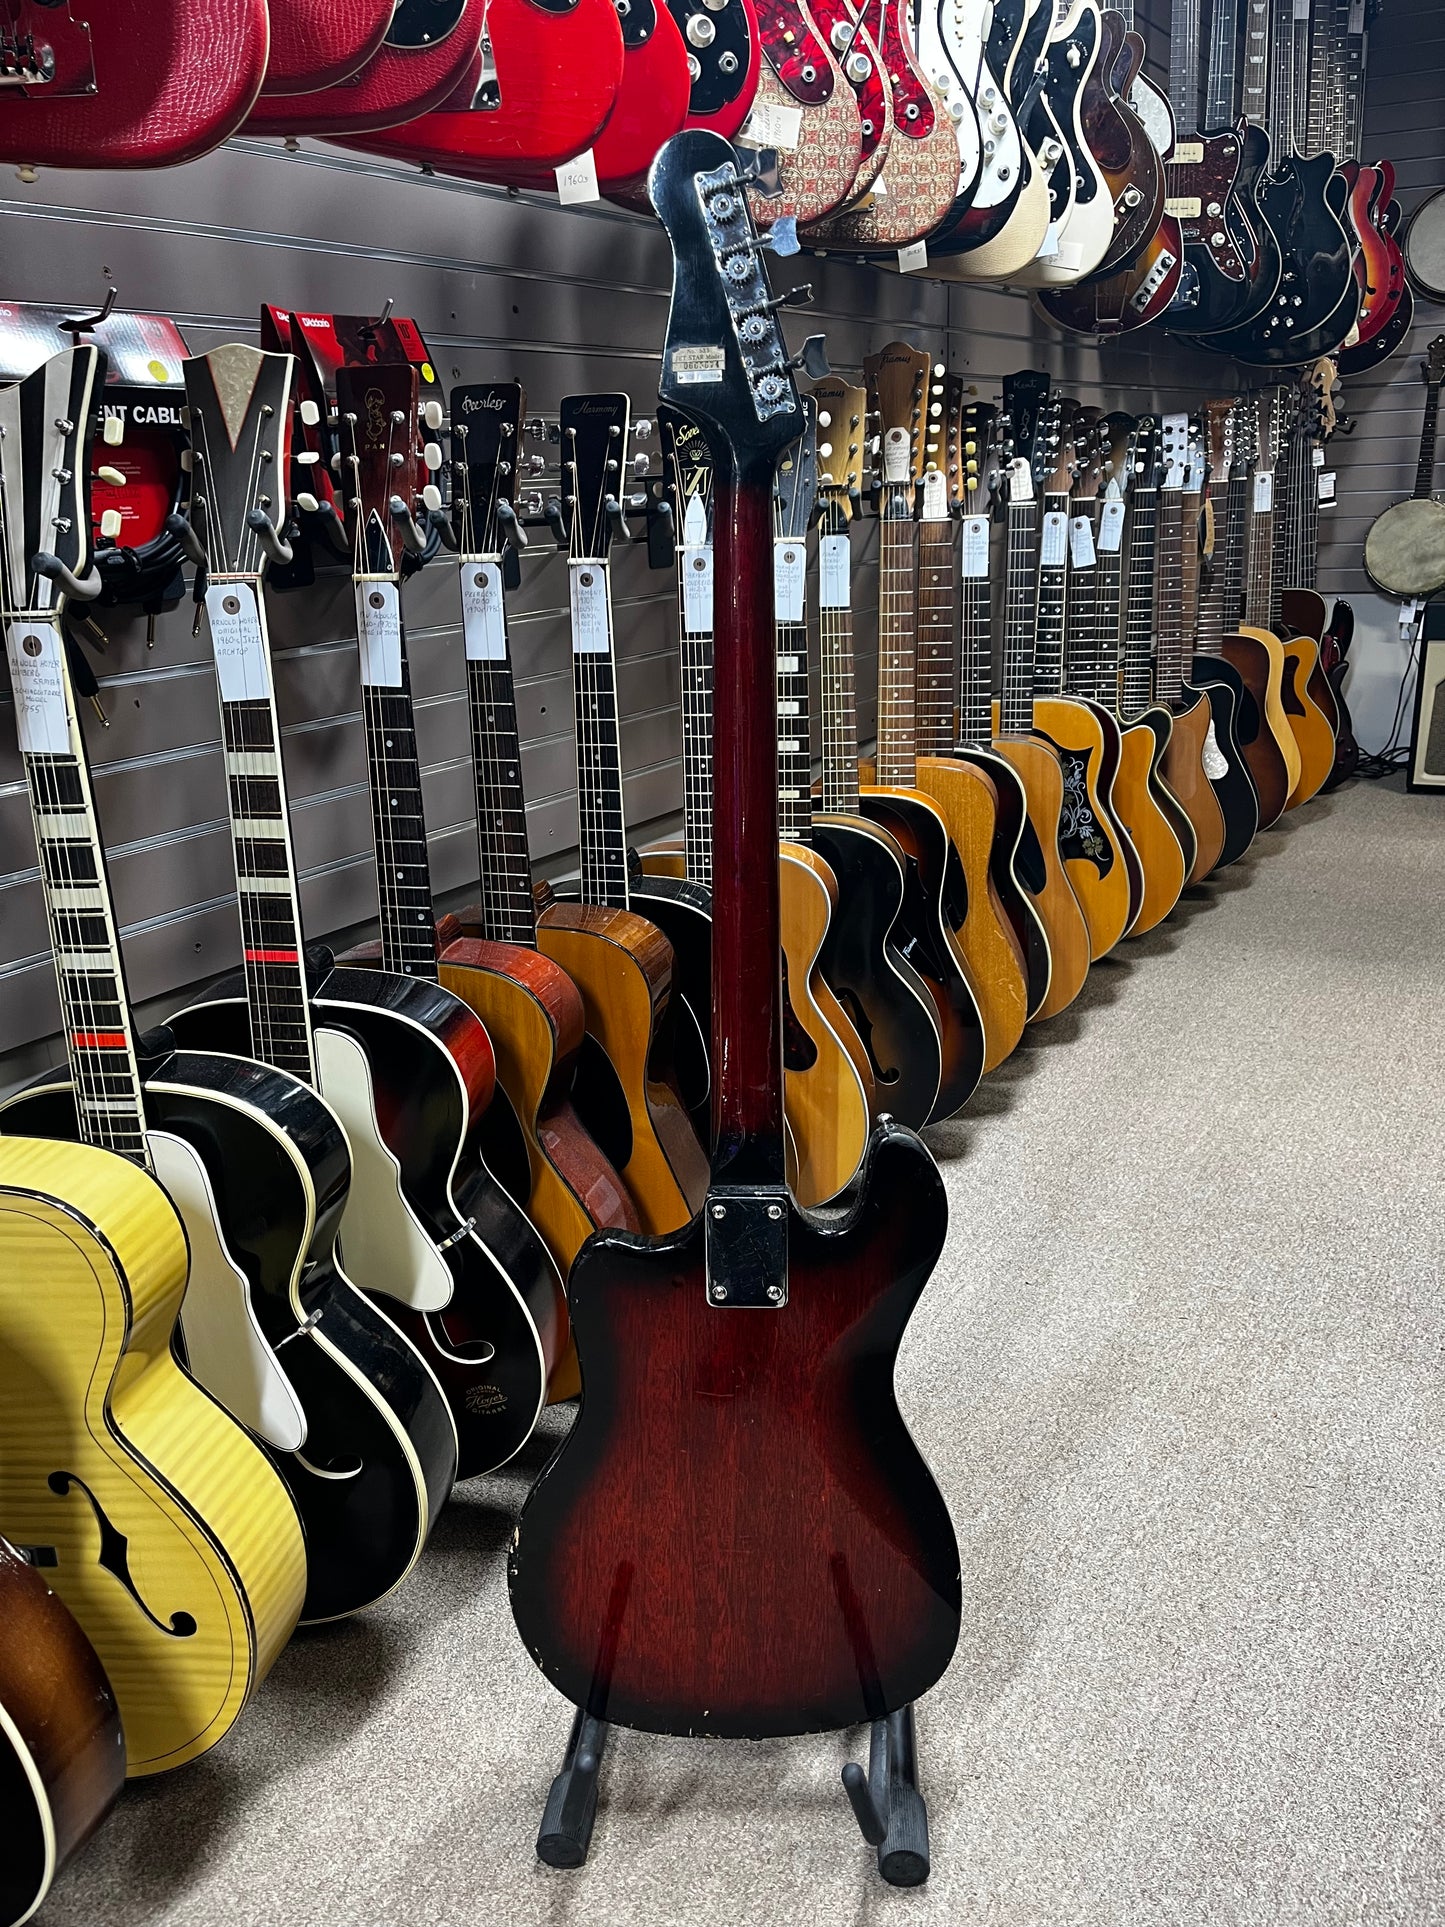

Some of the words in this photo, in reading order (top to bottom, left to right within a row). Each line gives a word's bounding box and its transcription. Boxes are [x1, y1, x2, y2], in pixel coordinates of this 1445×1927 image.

[461, 391, 507, 415] Peerless
[572, 401, 619, 417] Harmony
[132, 406, 184, 425] CABL
[465, 1384, 502, 1395] ORIGINAL
